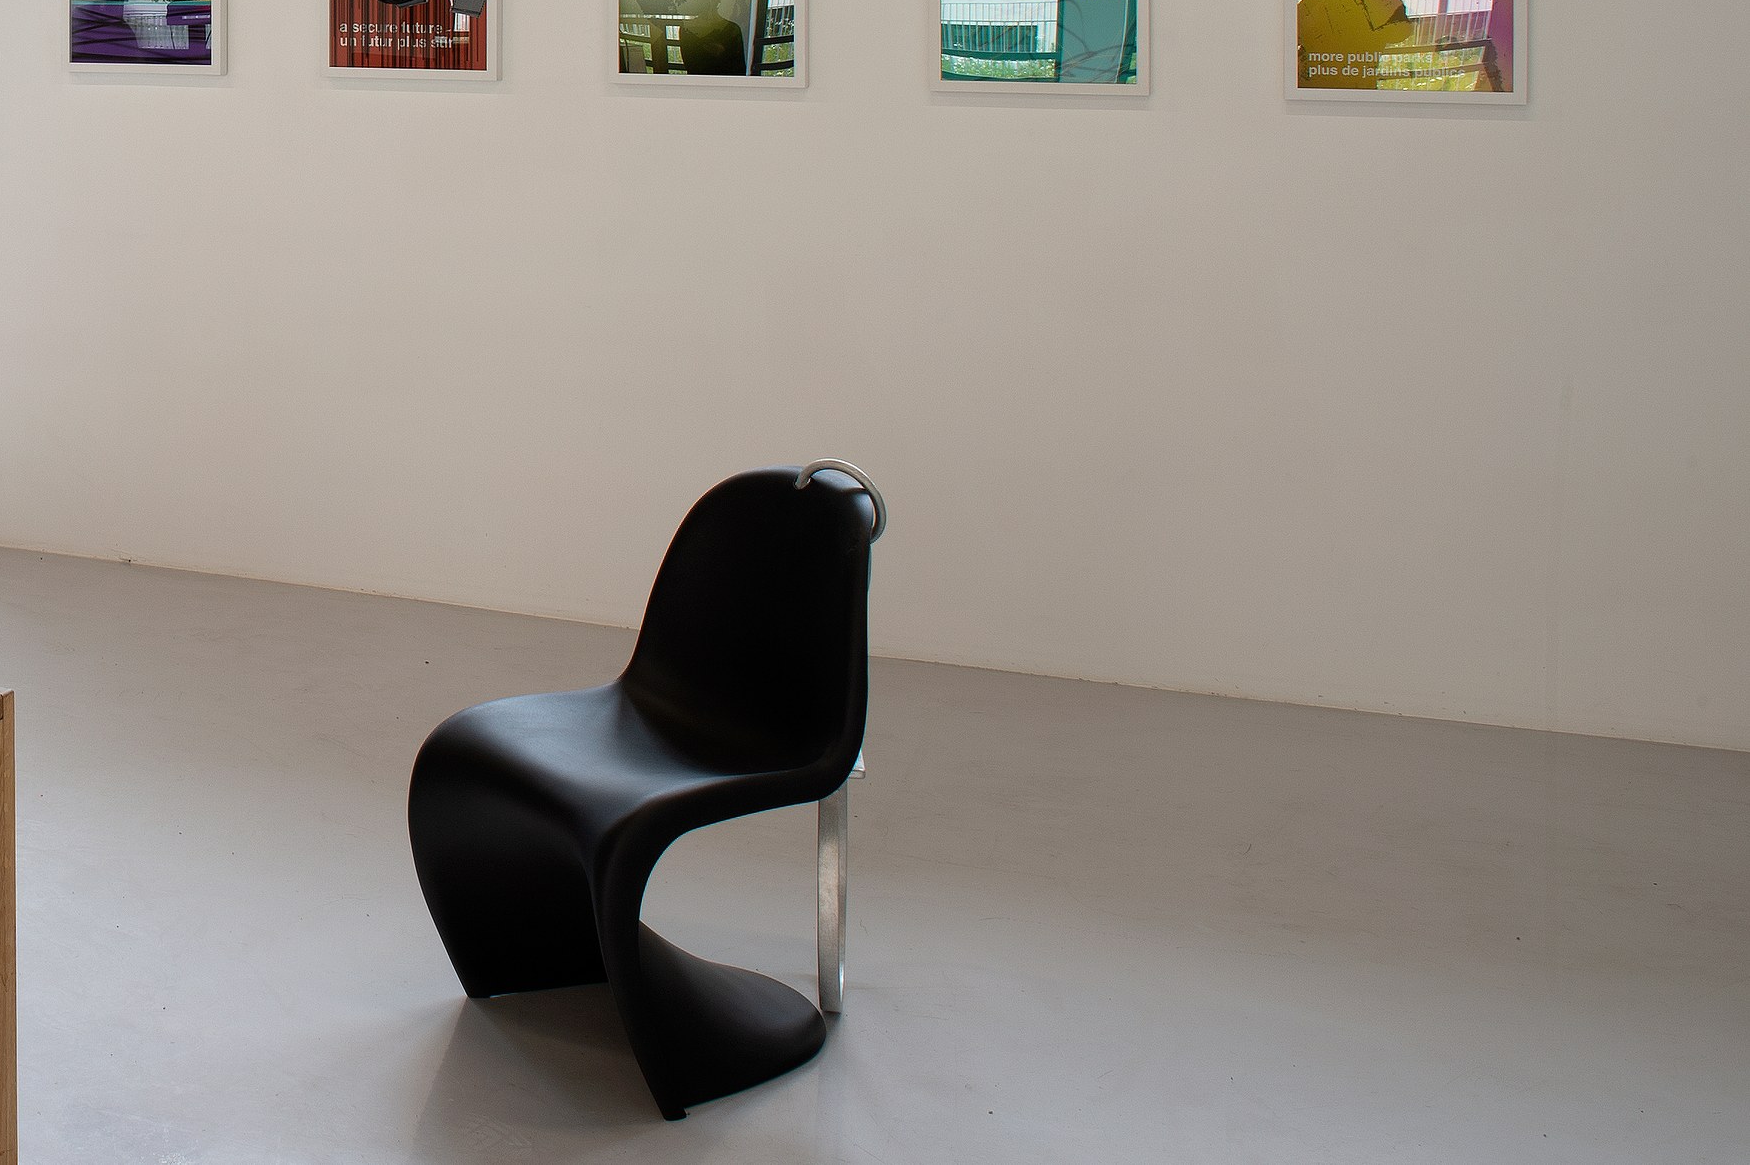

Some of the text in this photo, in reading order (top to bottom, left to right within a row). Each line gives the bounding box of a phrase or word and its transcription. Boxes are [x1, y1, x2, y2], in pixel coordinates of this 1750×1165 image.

[339, 21, 443, 34] a secure future
[340, 36, 357, 47] un
[361, 35, 393, 48] futur
[397, 35, 427, 51] plus
[1308, 52, 1344, 62] more
[1347, 51, 1389, 64] public
[1308, 65, 1338, 77] plus
[1341, 65, 1359, 76] de
[1362, 65, 1410, 78] jardins
